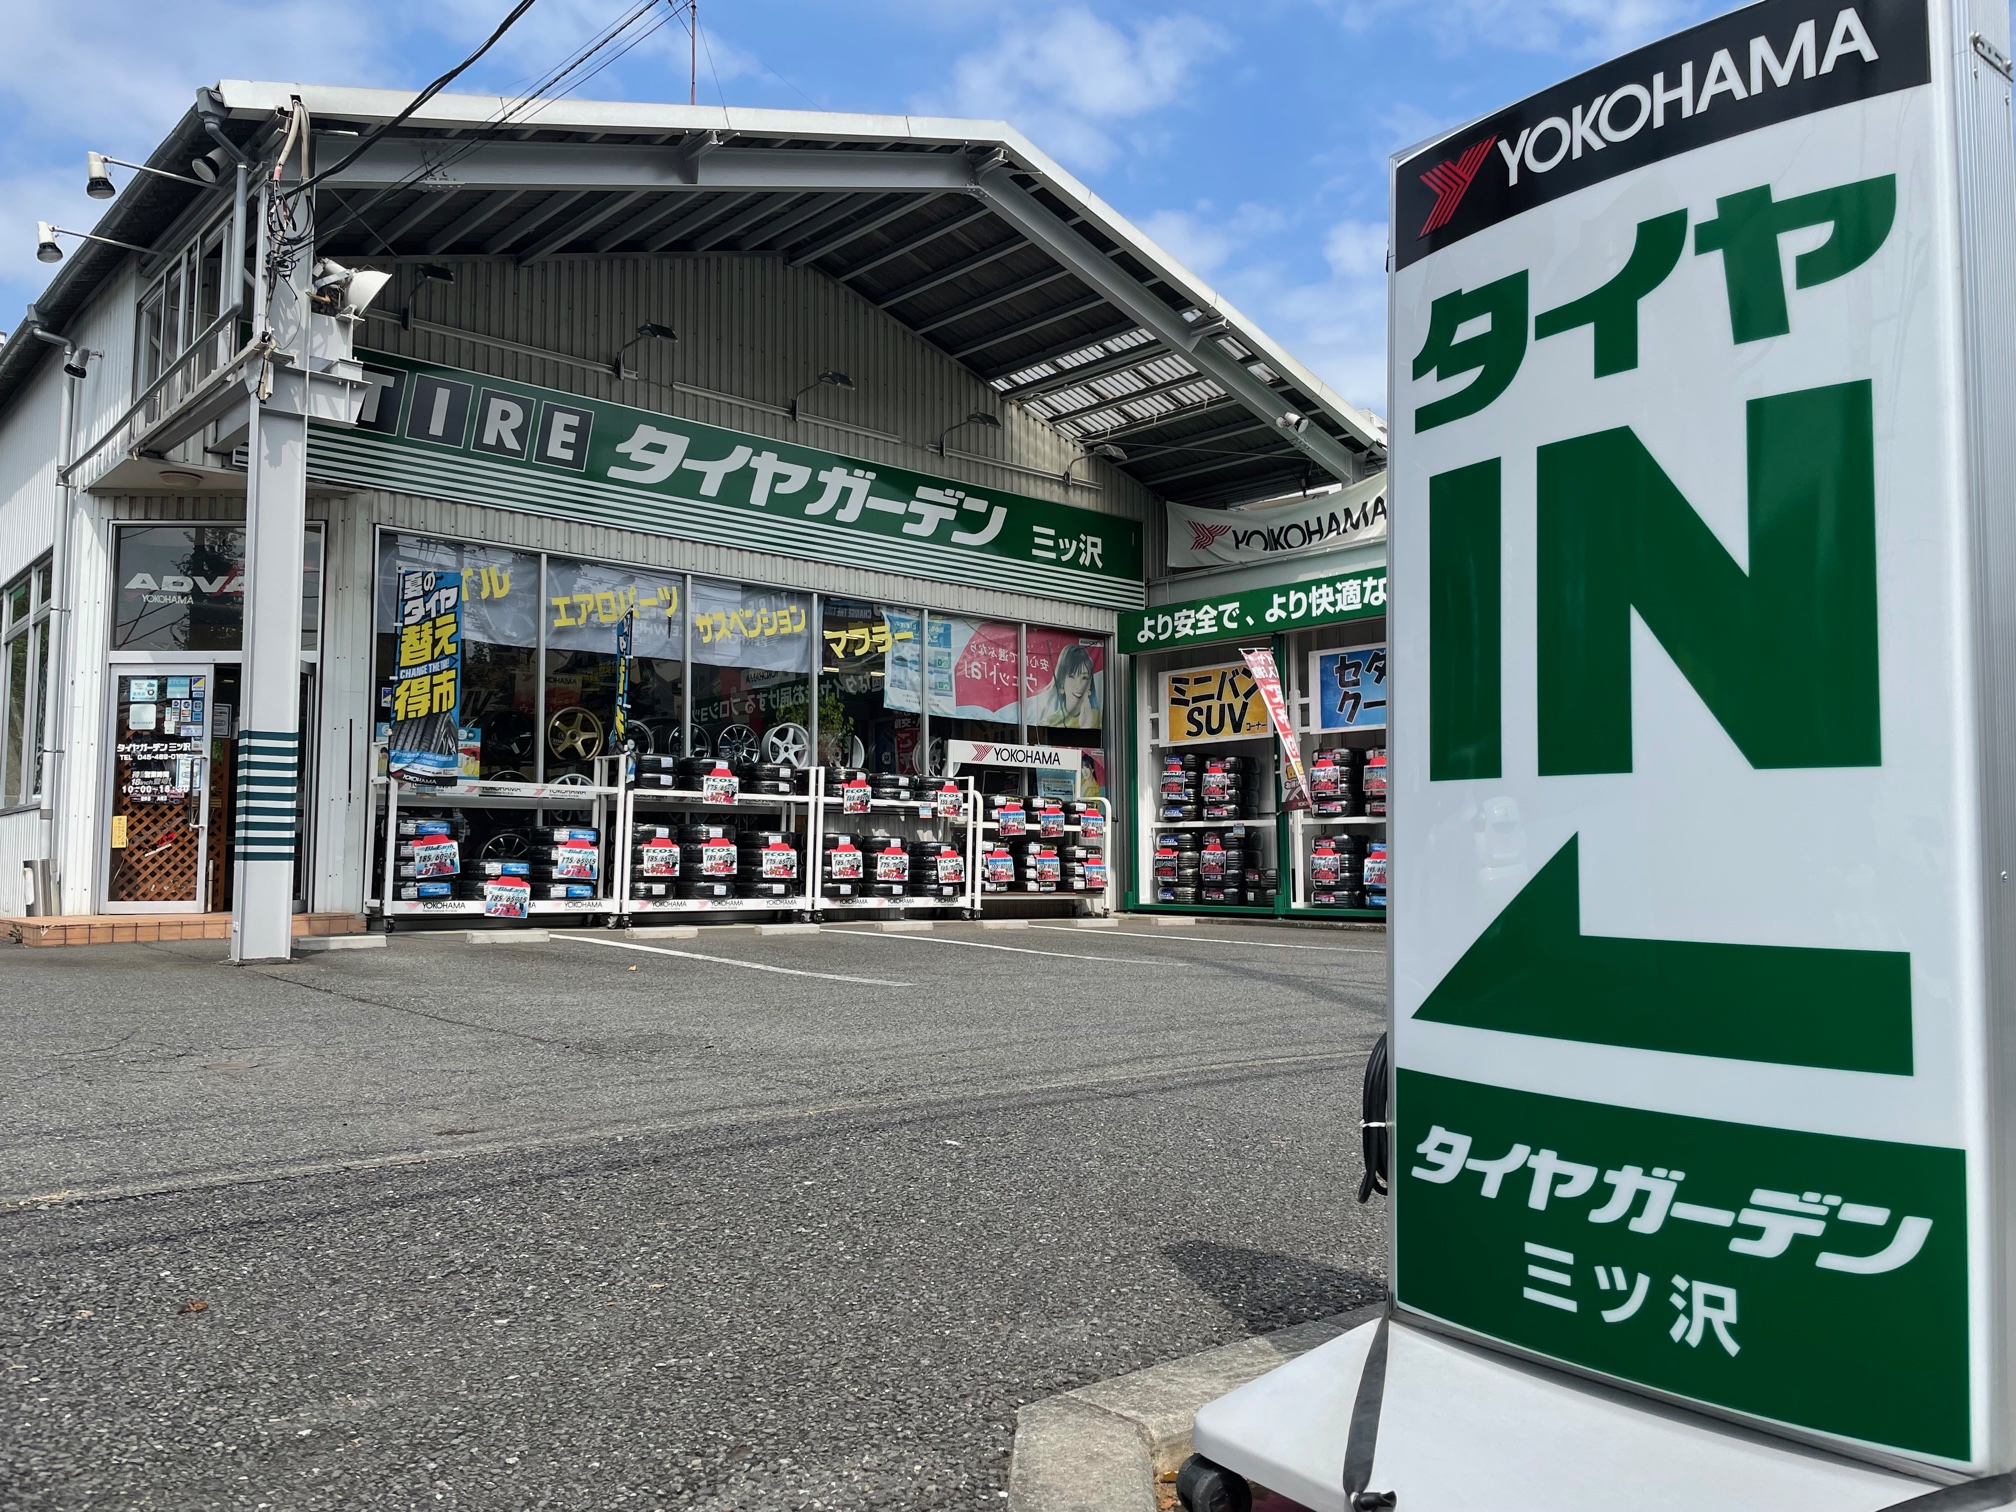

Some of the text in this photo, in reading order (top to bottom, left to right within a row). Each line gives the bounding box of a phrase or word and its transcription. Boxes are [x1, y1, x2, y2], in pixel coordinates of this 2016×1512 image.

[1498, 7, 1879, 187] YOKOHAMA
[1412, 173, 1897, 434] タイヤ
[361, 369, 582, 461] TIRE
[607, 424, 1008, 546] タイヤガーデン
[142, 594, 194, 605] YOKOHAMA
[404, 572, 436, 600] 夏の
[1430, 379, 1882, 782] IN
[404, 587, 458, 625] タイヤ
[551, 585, 678, 627] エアロパーツ
[695, 605, 806, 644] サスペンション
[400, 613, 457, 667] 替え
[824, 624, 914, 659] マフラー
[394, 669, 456, 721] 得市
[1186, 701, 1250, 737] SUV
[117, 743, 168, 752] タイヤガーデン
[994, 747, 1061, 766] YOKOHAMA
[1411, 1125, 1933, 1274] タイヤガーデン
